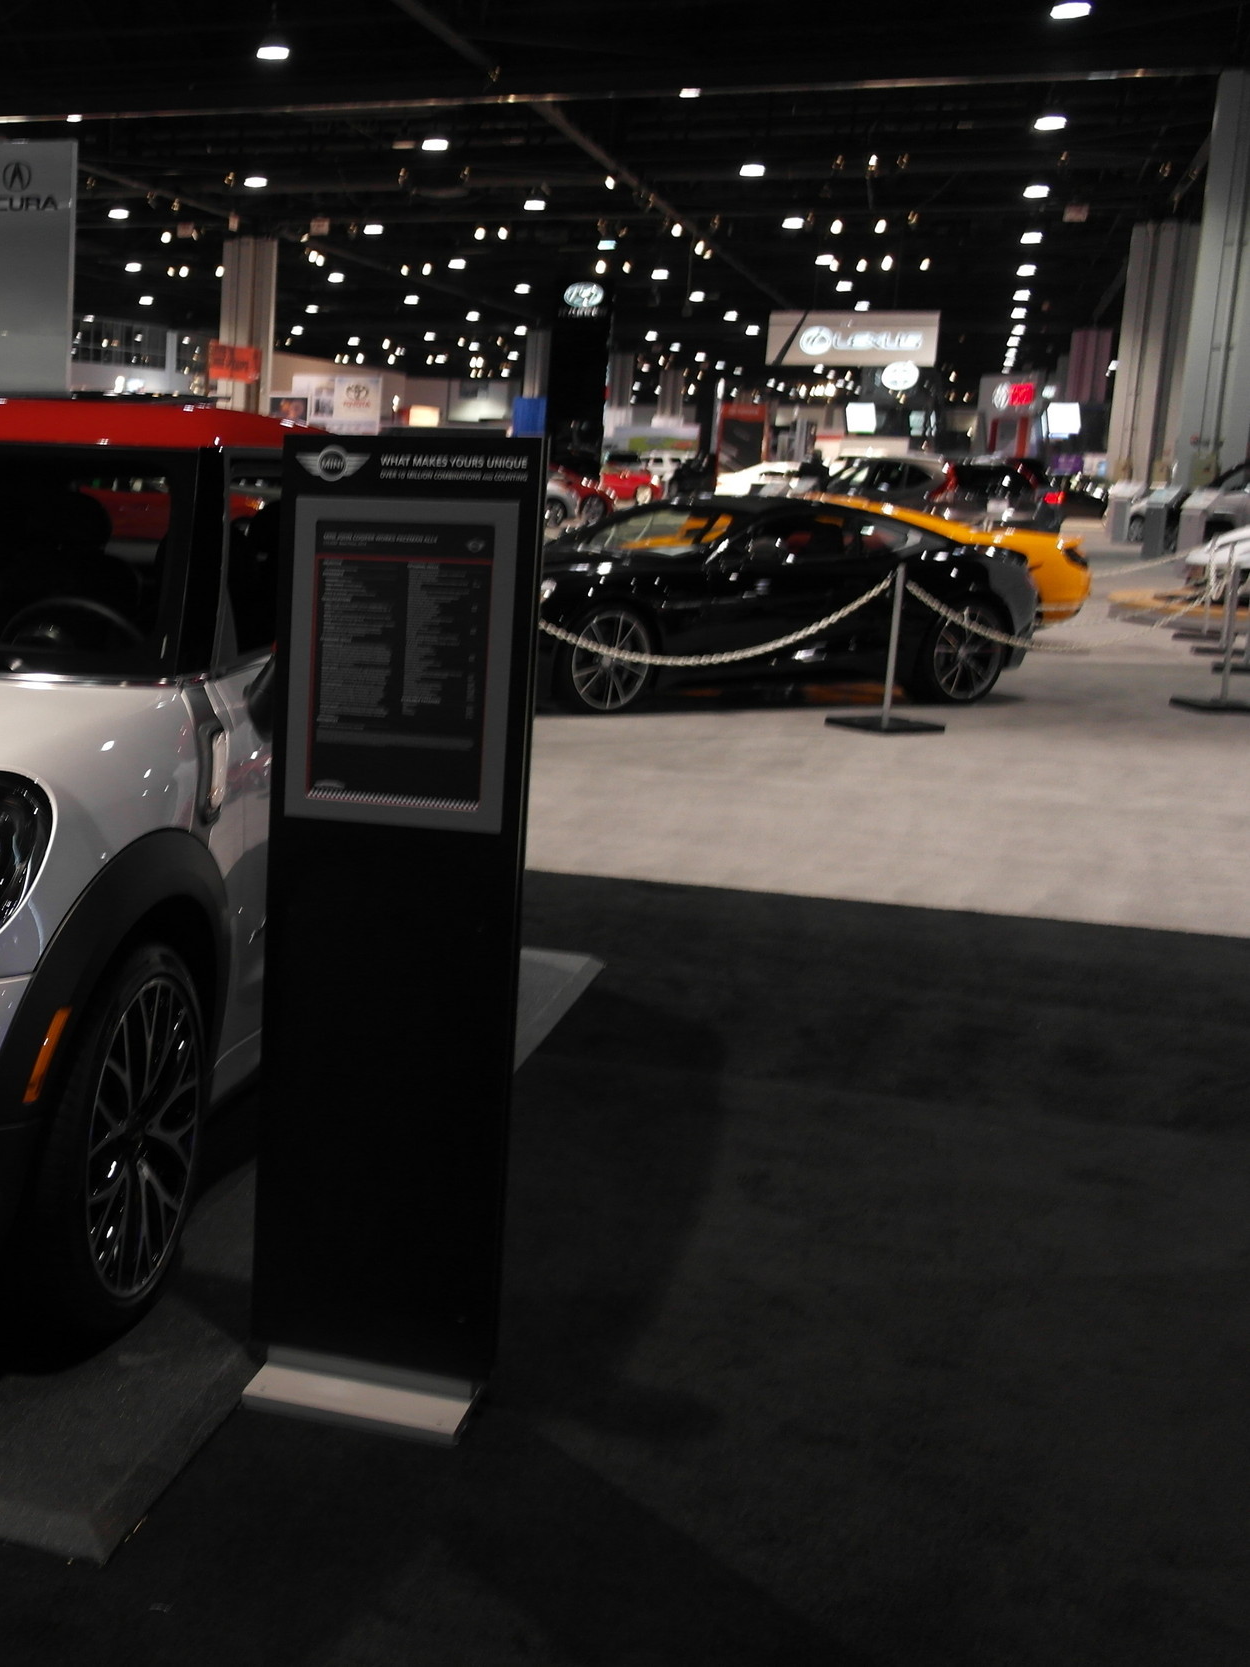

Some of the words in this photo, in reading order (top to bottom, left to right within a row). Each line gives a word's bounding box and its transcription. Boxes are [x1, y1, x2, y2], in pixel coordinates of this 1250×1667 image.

[832, 331, 923, 350] LEXUS
[321, 458, 344, 470] MINI
[380, 453, 410, 467] WHAT
[412, 453, 448, 468] MAKES
[449, 454, 485, 469] YOURS
[486, 455, 528, 470] UNIQUE
